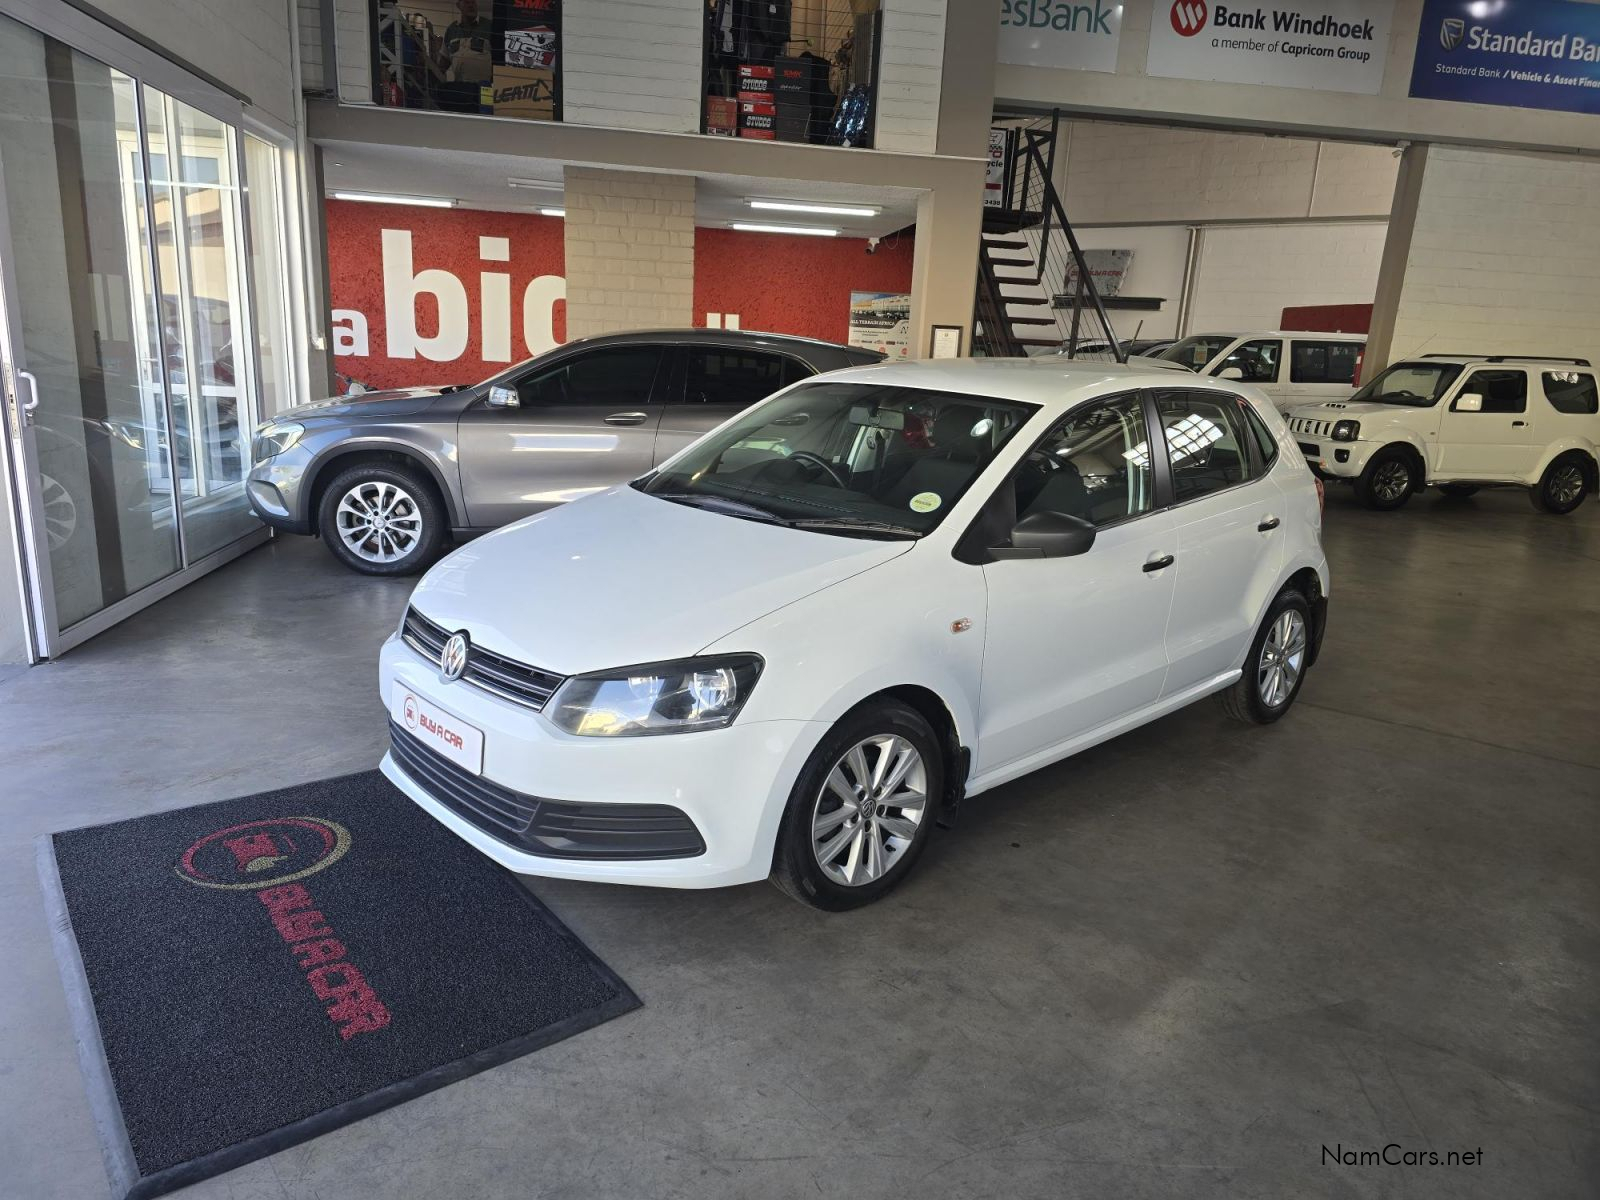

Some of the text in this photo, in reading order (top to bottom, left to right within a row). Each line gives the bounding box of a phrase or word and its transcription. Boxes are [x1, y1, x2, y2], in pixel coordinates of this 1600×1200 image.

[1213, 5, 1375, 41] Bank Windhoek
[1211, 38, 1371, 63] a member of Capricorn Group
[1467, 26, 1568, 59] Standard
[1435, 63, 1478, 77] Standard
[1478, 67, 1501, 79] Bank
[1510, 70, 1543, 83] Vehicle
[1543, 73, 1551, 84] &
[1553, 75, 1578, 86] Asset
[331, 308, 369, 357] a
[420, 713, 463, 750] BUY A CAR
